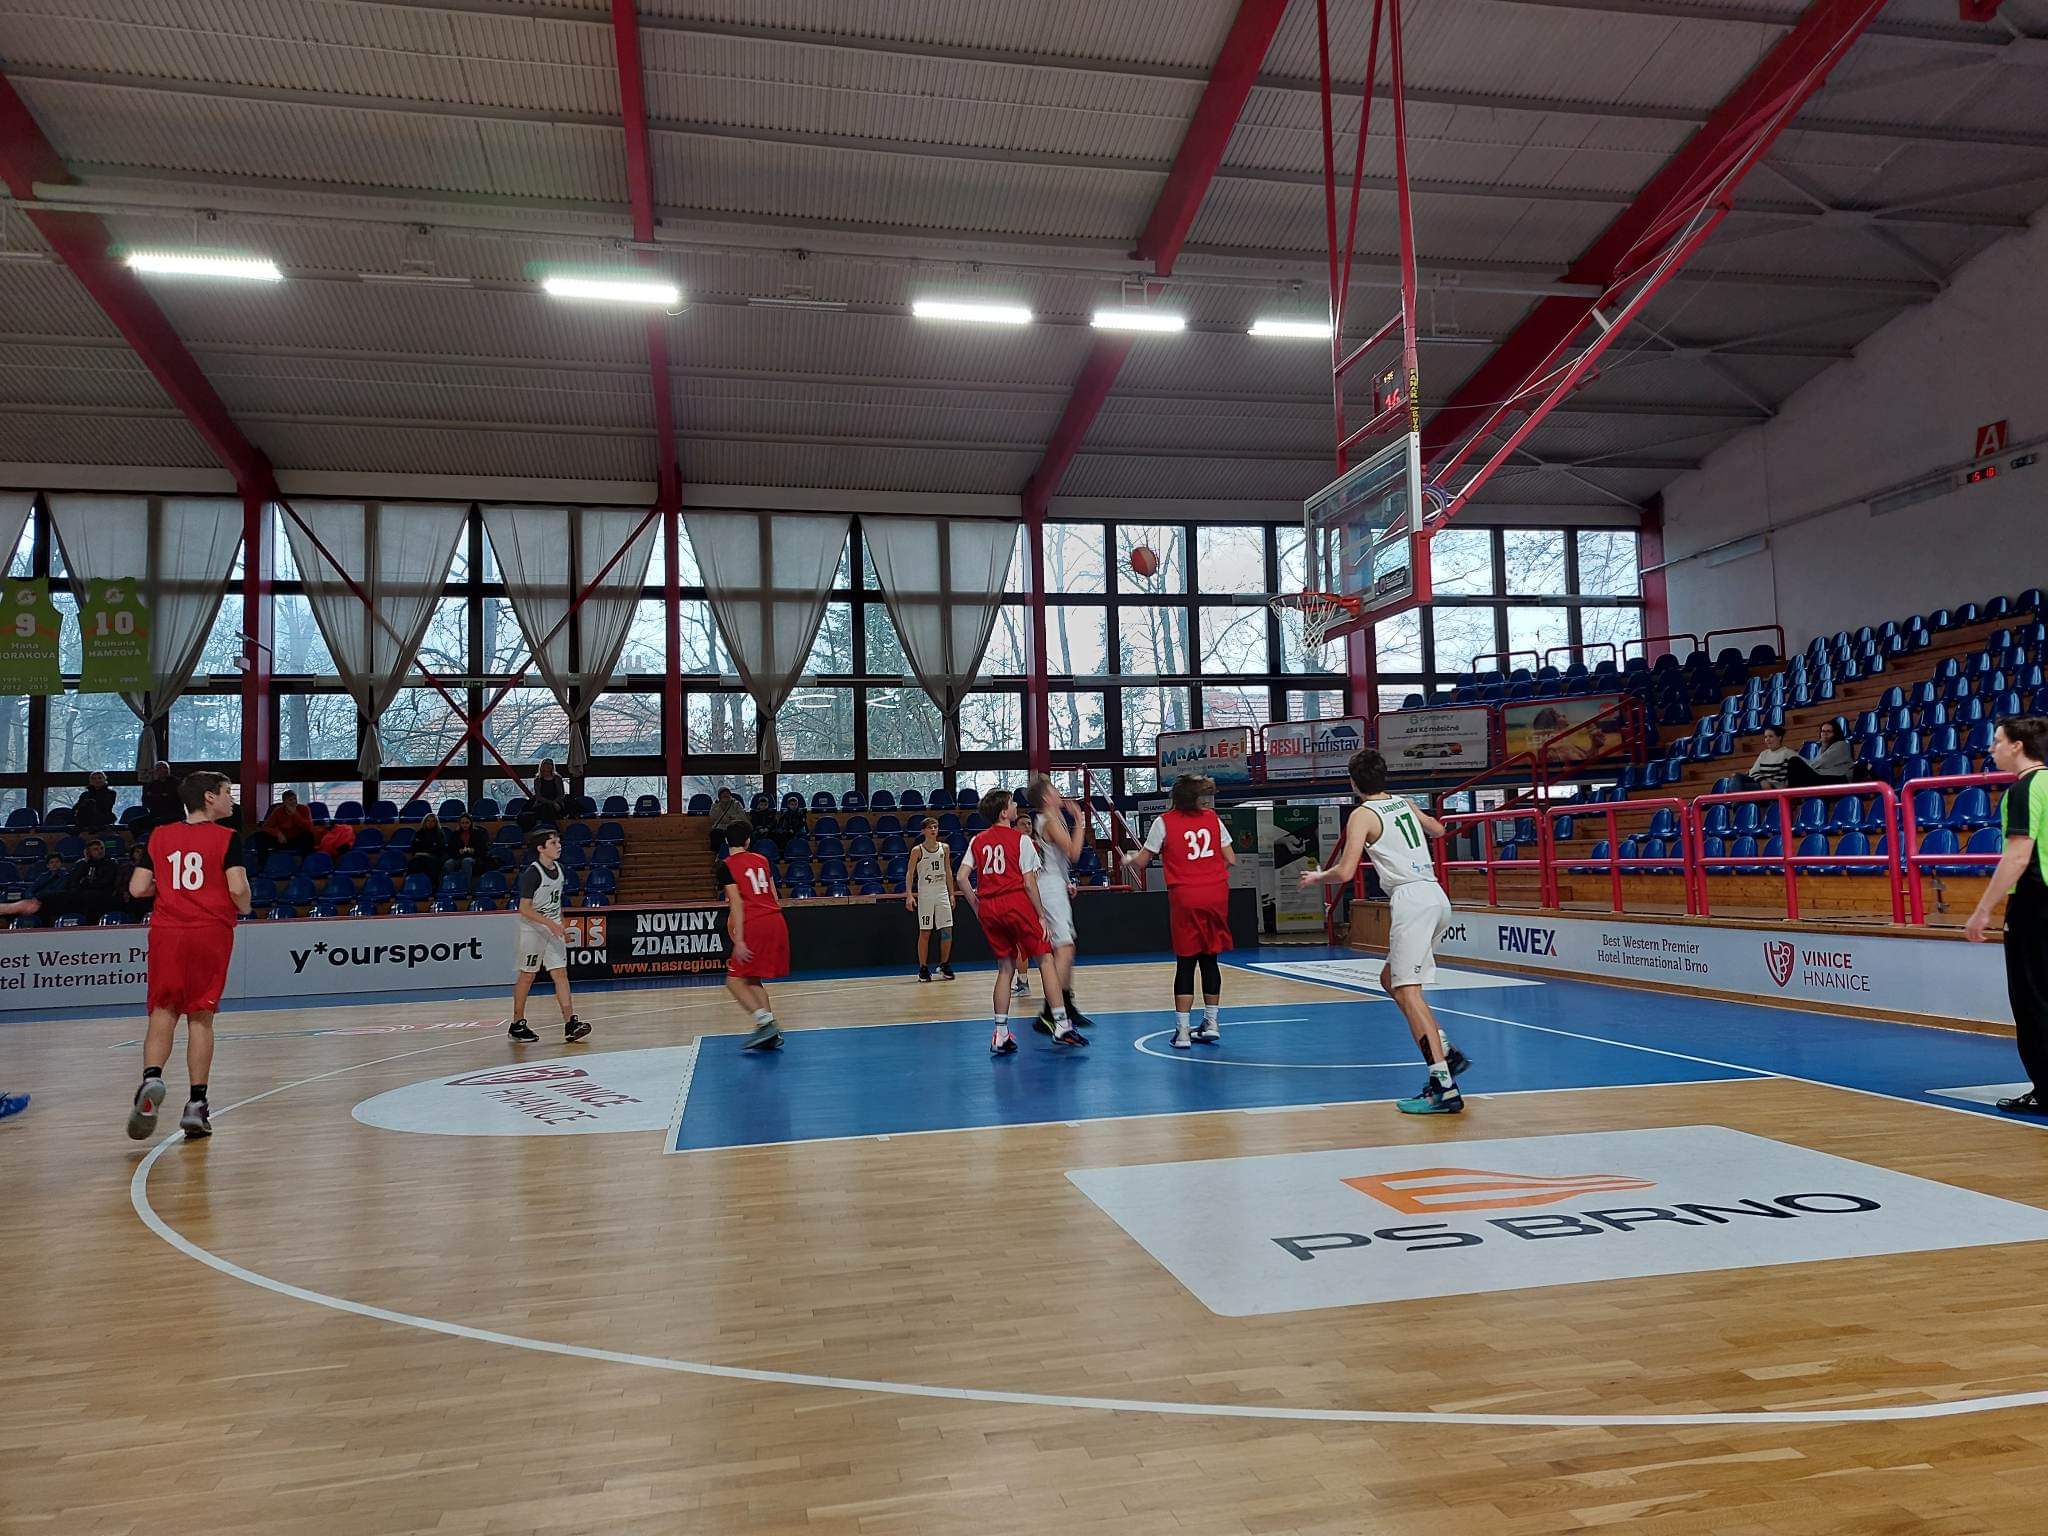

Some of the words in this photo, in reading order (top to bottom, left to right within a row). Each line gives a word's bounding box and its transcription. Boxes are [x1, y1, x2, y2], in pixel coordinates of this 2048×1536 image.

[1979, 424, 2000, 457] A
[15, 612, 36, 638] 9
[95, 611, 134, 636] 10
[0, 651, 56, 660] ORAKOVA
[1161, 743, 1208, 768] MRÁZ
[1209, 736, 1246, 759] LÉČÍ
[1303, 733, 1359, 753] Profistav
[1395, 812, 1421, 850] 17
[1184, 828, 1215, 861] 32
[166, 850, 205, 891] 18
[982, 844, 1005, 875] 28
[744, 867, 769, 895] 14
[565, 919, 605, 947] áš
[636, 911, 718, 933] NOVINY
[631, 933, 724, 956] ZDARMA
[1498, 925, 1557, 957] FAVEX
[1602, 934, 1621, 948] Best
[1622, 936, 1660, 952] Western
[1662, 938, 1700, 954] Premier
[0, 953, 30, 969] est
[37, 950, 122, 967] Western
[570, 950, 607, 965] ION
[612, 958, 732, 974] www.nasregion.c
[1597, 949, 1621, 964] Hotel
[1622, 951, 1682, 971] International
[1685, 958, 1709, 974] Brno
[1802, 950, 1853, 969] VINICE
[0, 972, 25, 990] tel
[33, 968, 149, 989] Internation
[1803, 971, 1872, 992] HNANICE
[546, 1080, 643, 1108] VINICE
[1271, 1222, 1484, 1262] PS
[1487, 1192, 1883, 1242] BRNO
